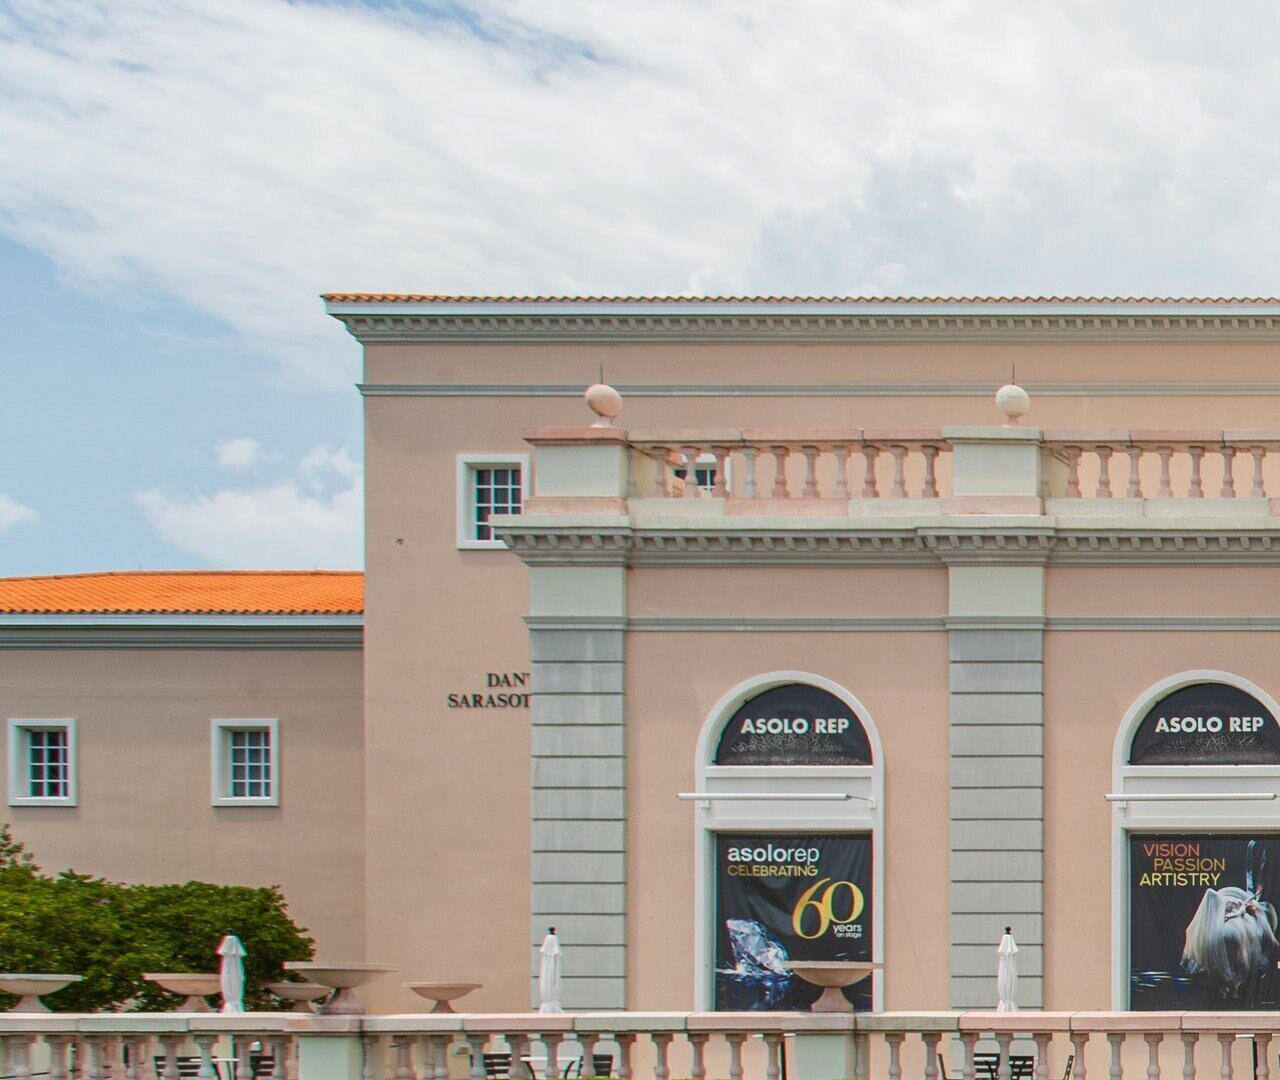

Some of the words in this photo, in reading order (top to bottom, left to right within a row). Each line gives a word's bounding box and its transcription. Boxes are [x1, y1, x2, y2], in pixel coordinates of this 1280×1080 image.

[486, 672, 530, 688] DAN
[741, 717, 809, 735] ASOLO
[814, 718, 850, 734] REP
[1155, 716, 1224, 733] ASOLO
[1229, 716, 1265, 732] REP
[727, 843, 820, 866] asolorep
[1143, 843, 1200, 858] VISION
[727, 864, 819, 877] CELEBRATING
[1153, 858, 1226, 872] PASSION
[1139, 872, 1222, 887] ARTISTRY
[792, 877, 865, 939] 60
[832, 924, 863, 934] years
